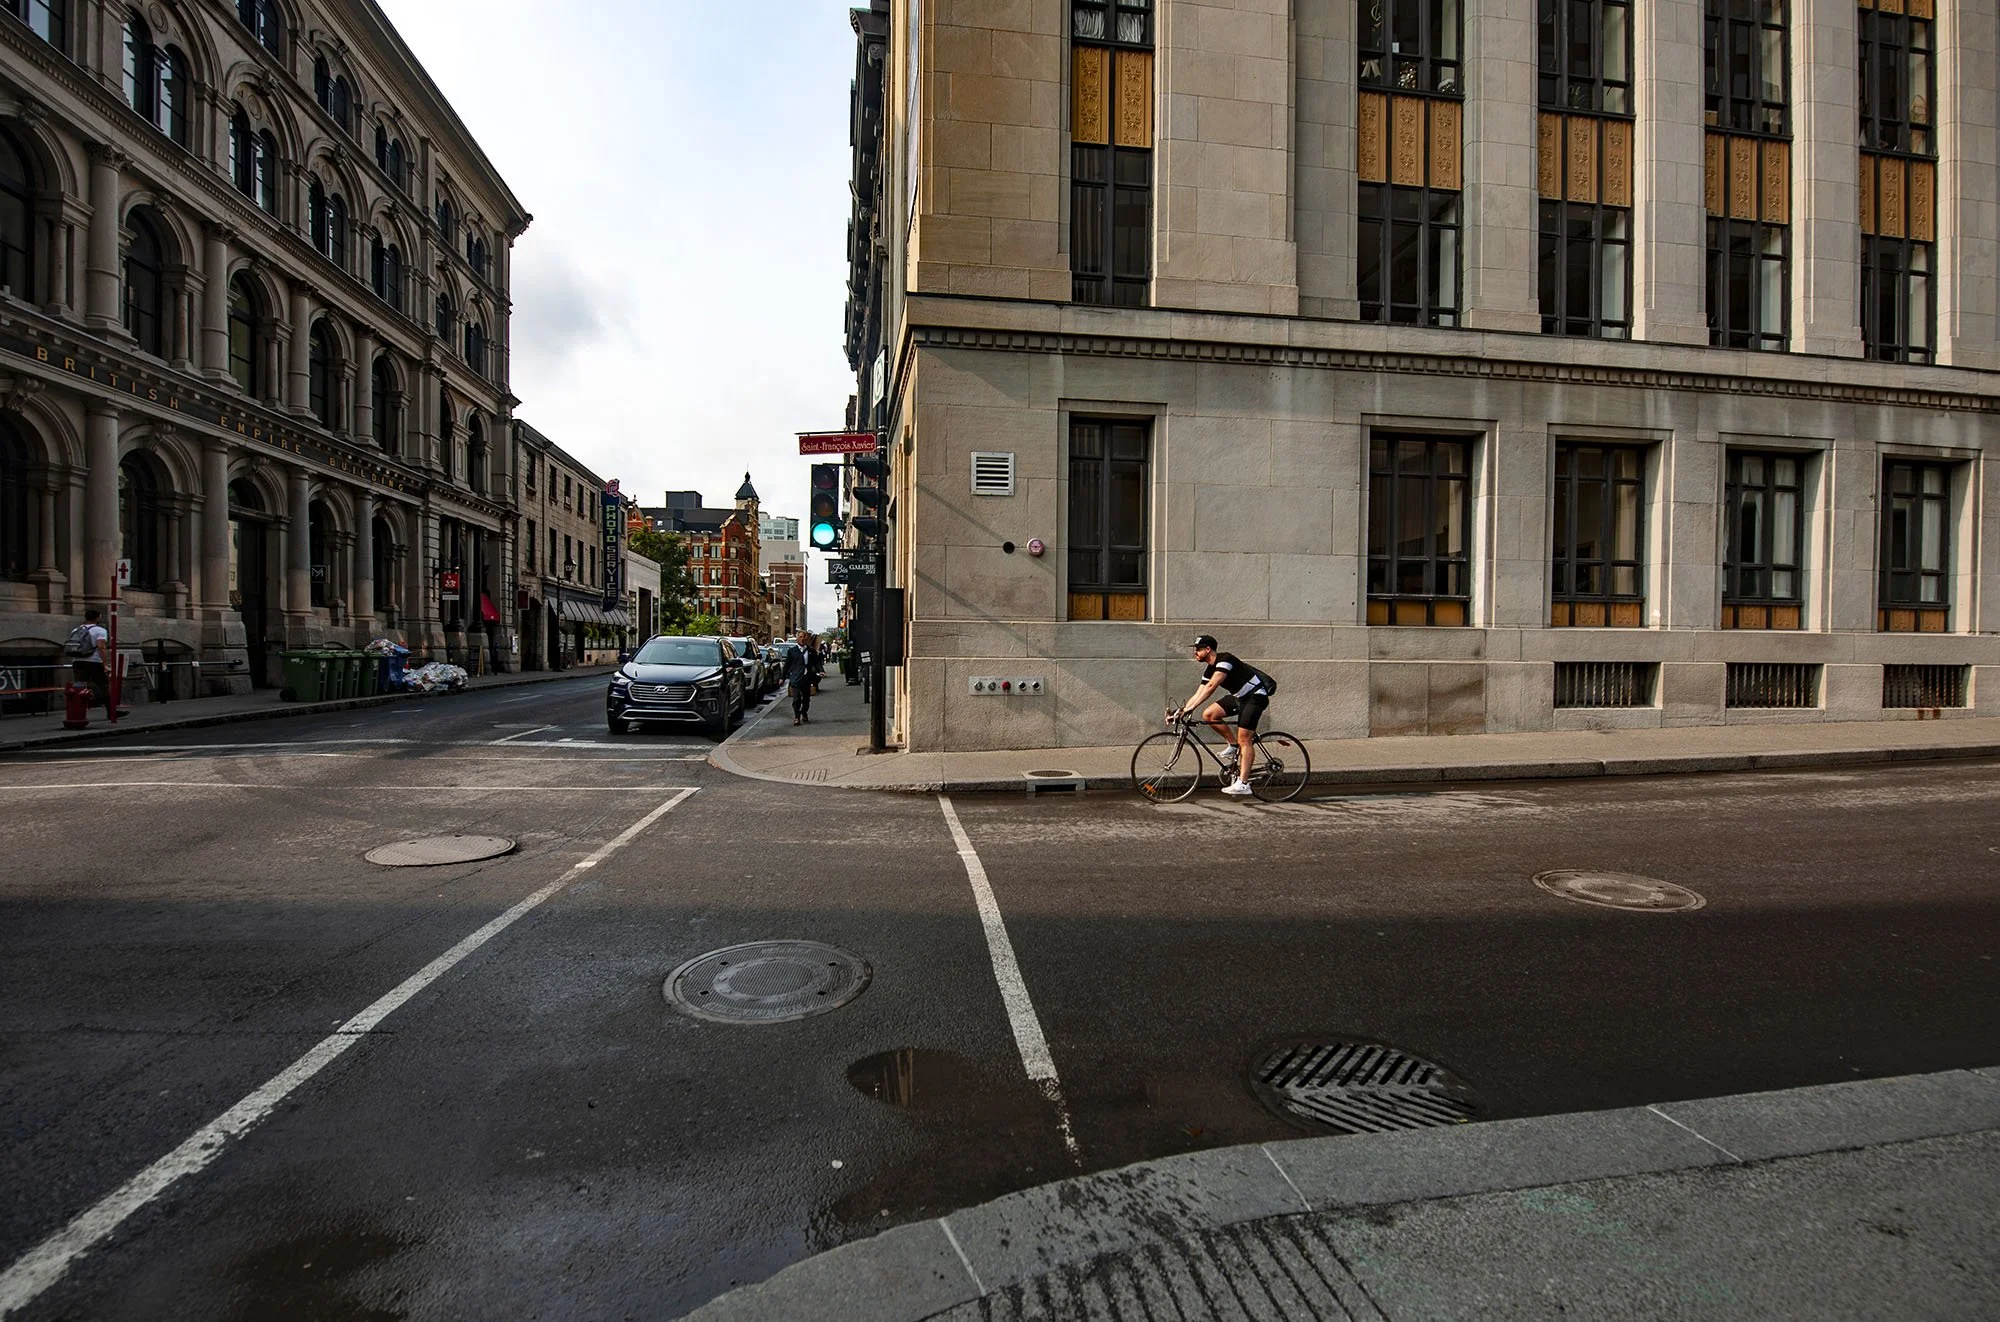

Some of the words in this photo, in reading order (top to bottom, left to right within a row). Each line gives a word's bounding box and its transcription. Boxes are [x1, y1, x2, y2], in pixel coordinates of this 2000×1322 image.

[36, 346, 179, 409] BRITISH
[220, 415, 301, 453] EMPIRE
[329, 457, 404, 492] BUILDING
[801, 442, 850, 452] Saint-François
[852, 441, 874, 450] Xavier
[606, 505, 616, 543] PHOTO
[606, 546, 616, 597] SERVICE
